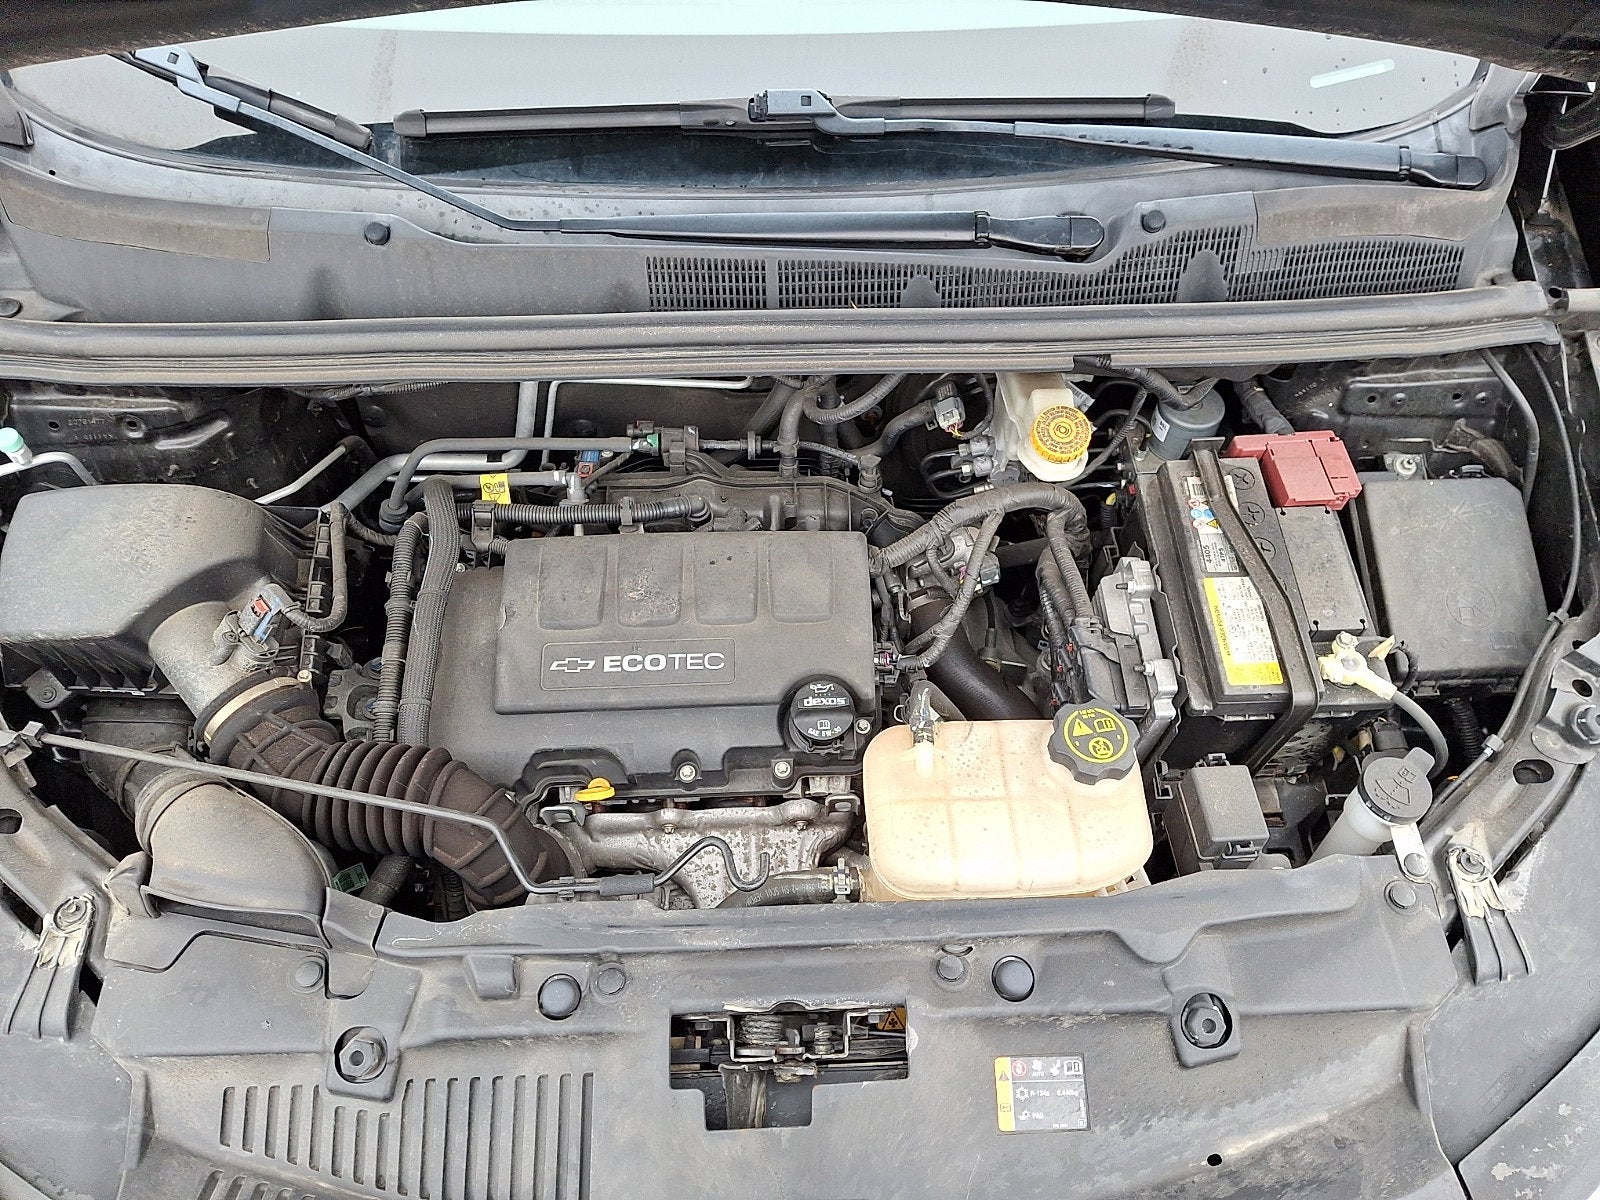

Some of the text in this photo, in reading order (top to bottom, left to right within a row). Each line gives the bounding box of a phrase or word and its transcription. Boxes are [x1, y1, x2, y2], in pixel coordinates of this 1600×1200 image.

[603, 652, 725, 673] ECOTEC
[803, 696, 847, 707] dexos
[807, 727, 820, 737] SAE
